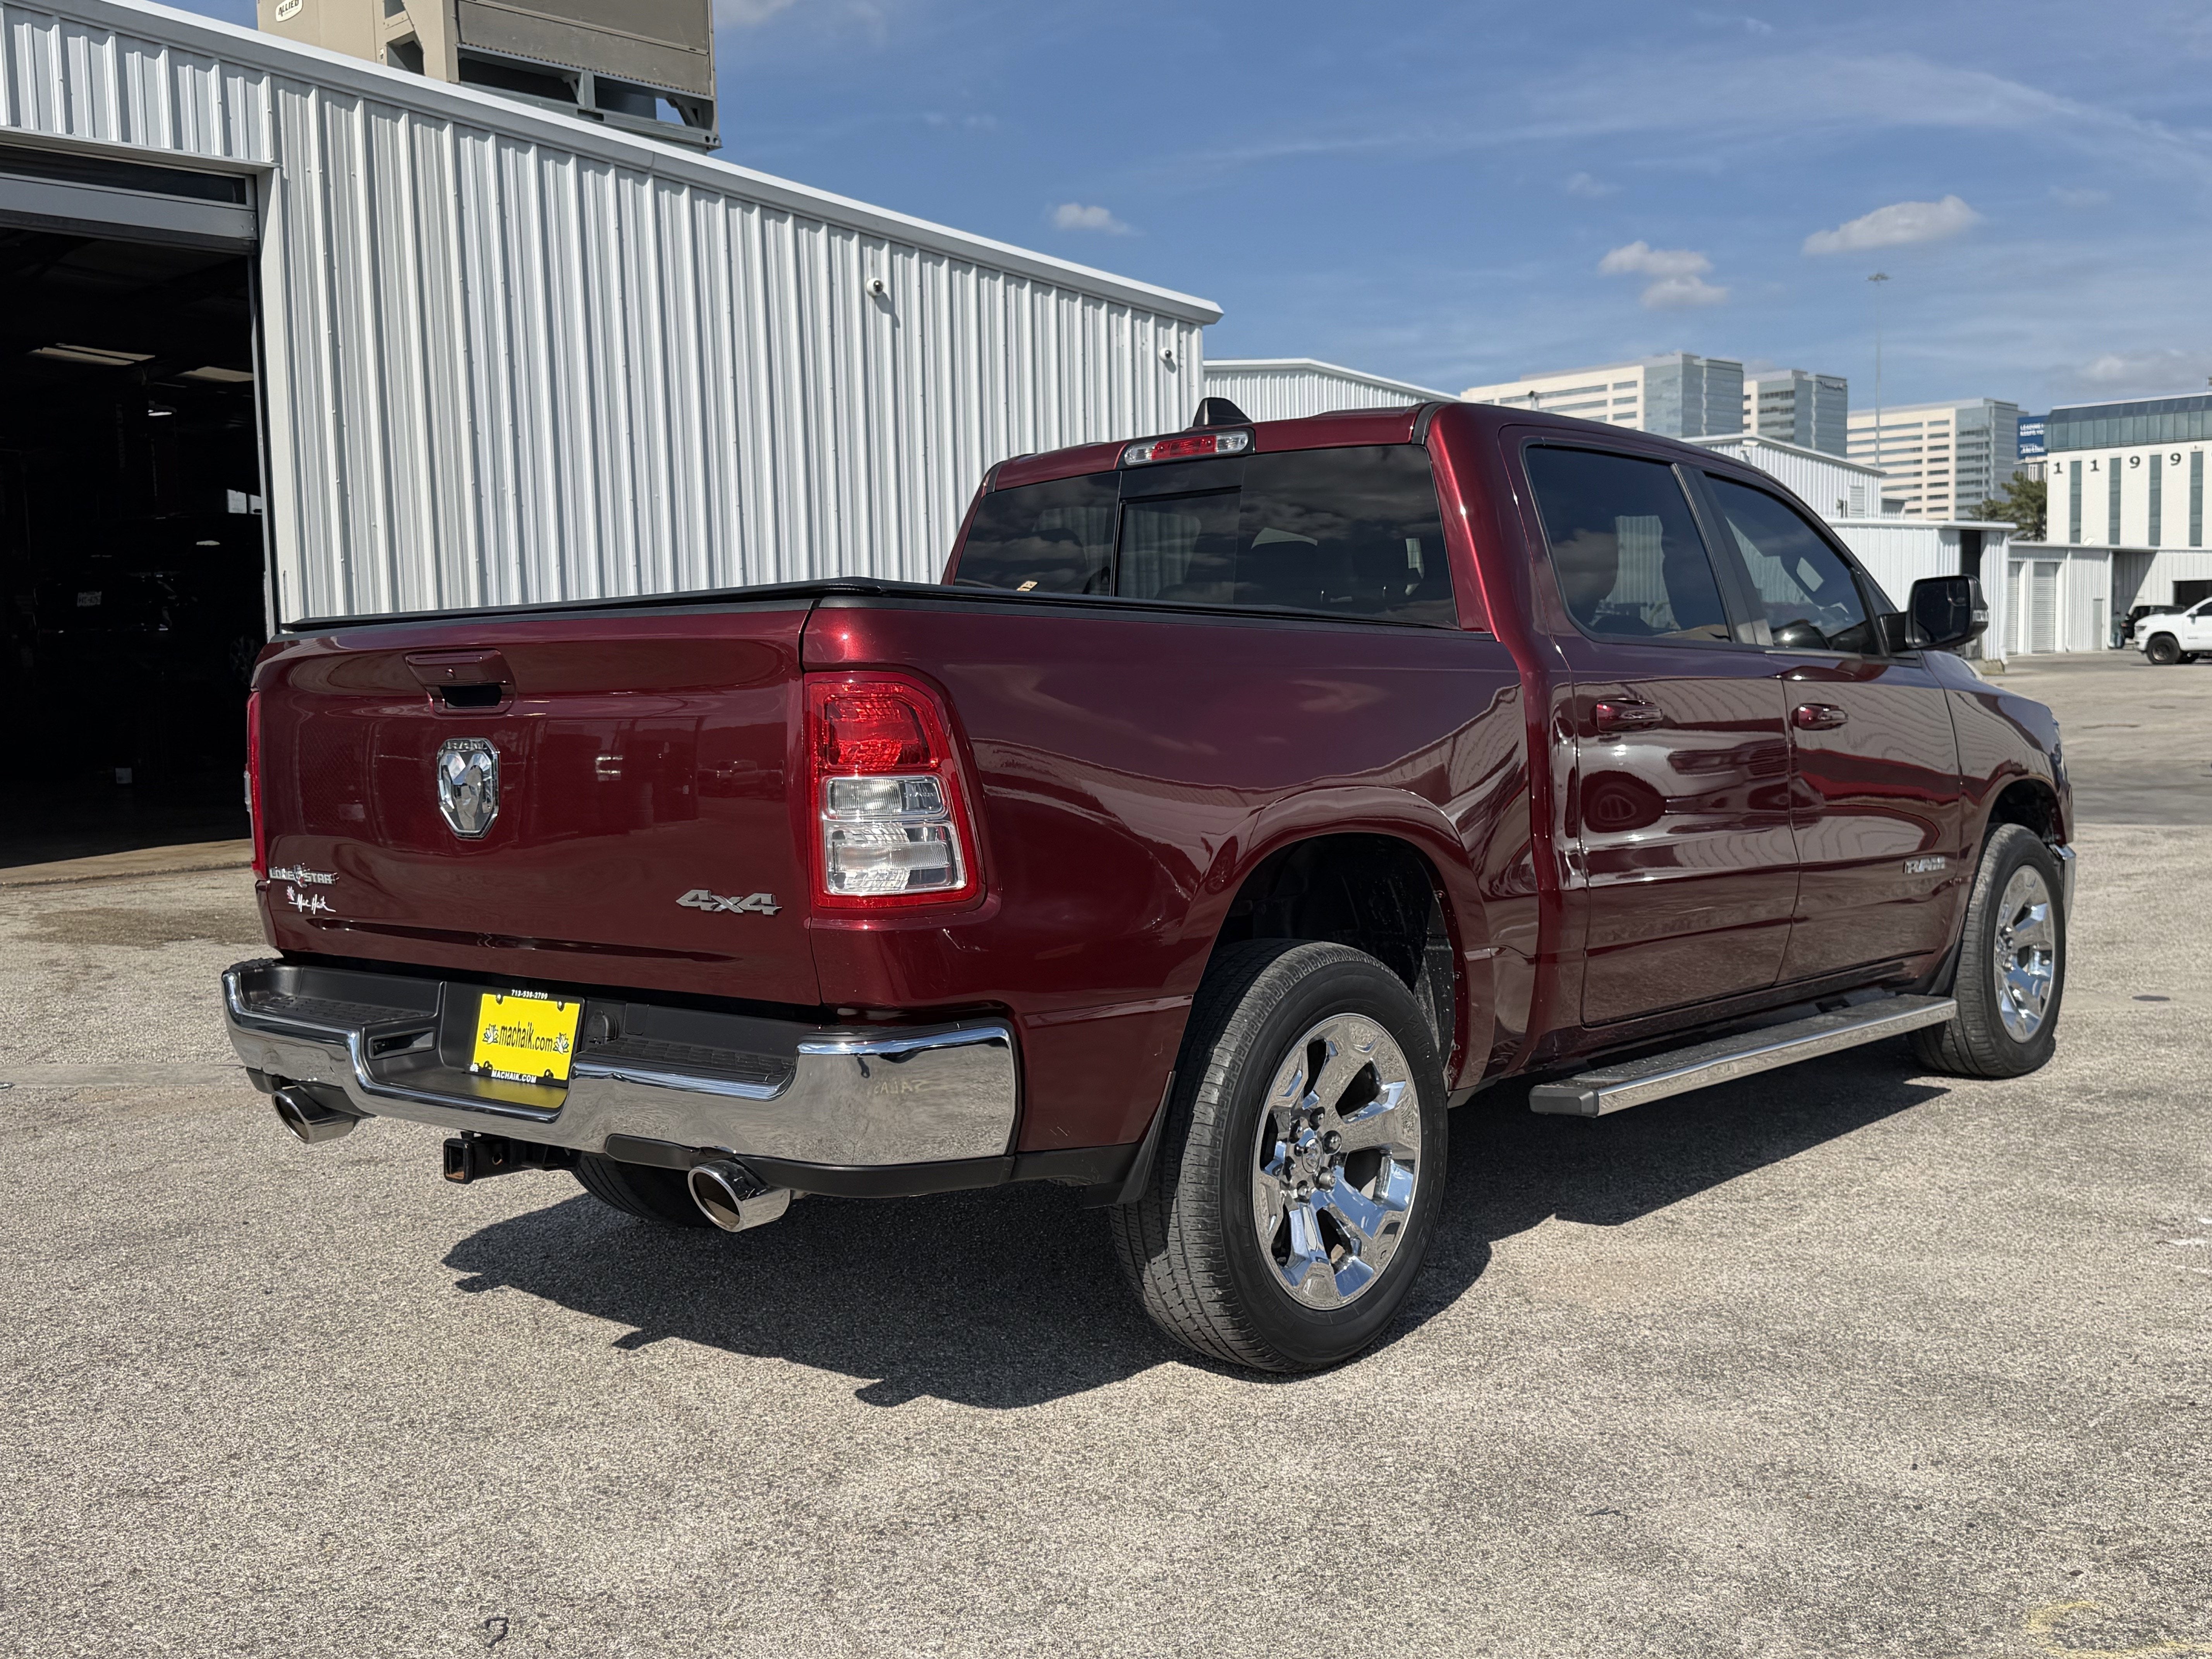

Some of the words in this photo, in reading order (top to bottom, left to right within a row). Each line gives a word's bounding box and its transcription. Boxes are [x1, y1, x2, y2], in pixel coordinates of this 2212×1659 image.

[278, 0, 299, 17] ALLIED
[447, 741, 488, 749] RAM
[304, 872, 334, 884] STAR
[499, 1021, 553, 1052] machaik.com
[491, 1070, 537, 1083] MACHAIK.COM
